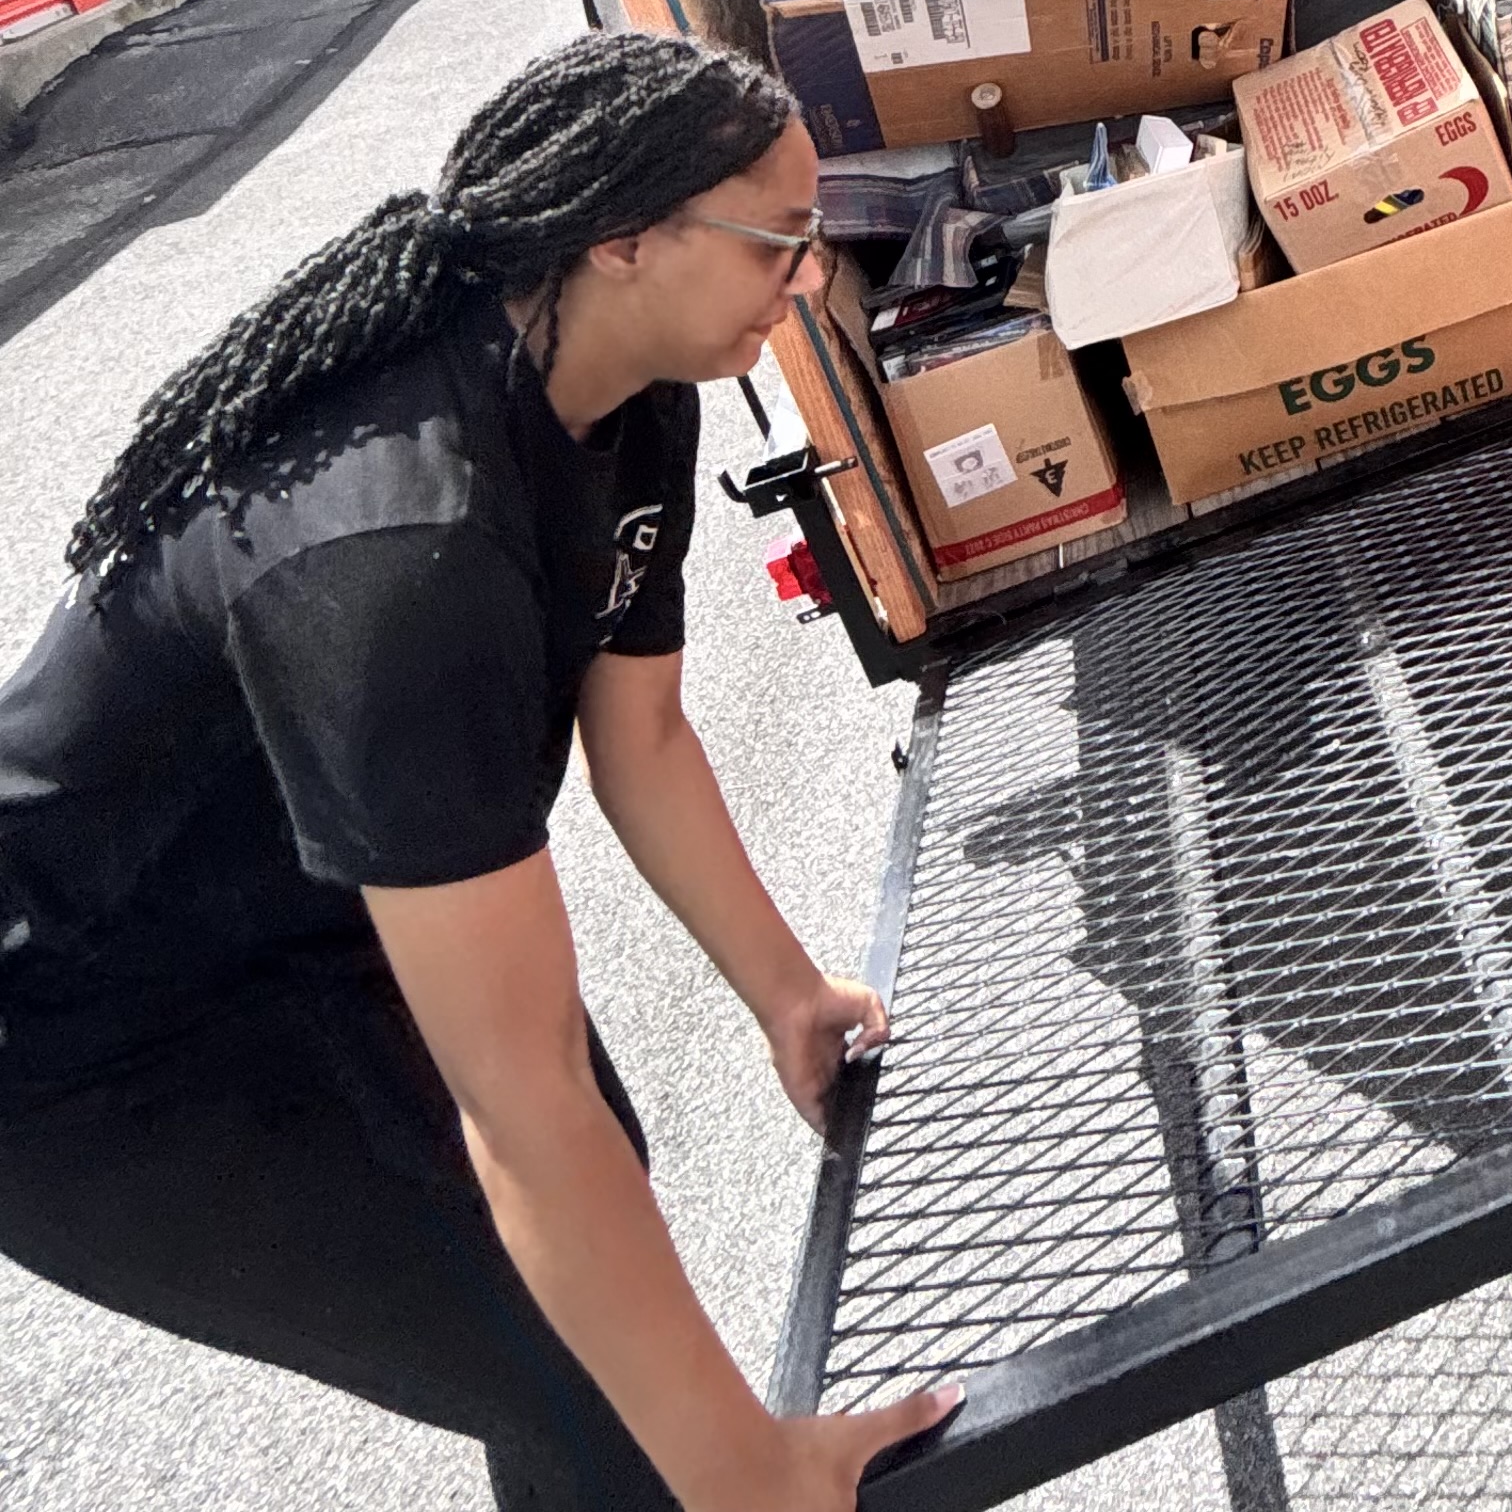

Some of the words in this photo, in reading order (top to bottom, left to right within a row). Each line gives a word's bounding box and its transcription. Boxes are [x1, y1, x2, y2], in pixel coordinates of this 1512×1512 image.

[1434, 111, 1477, 147] EGGS
[1273, 198, 1299, 223] 15
[1300, 178, 1340, 211] DOZ.
[1279, 335, 1436, 416] EGGS
[1238, 435, 1306, 476] KEEP
[1315, 367, 1505, 449] REFRIGERATED
[1043, 468, 1059, 485] 3
